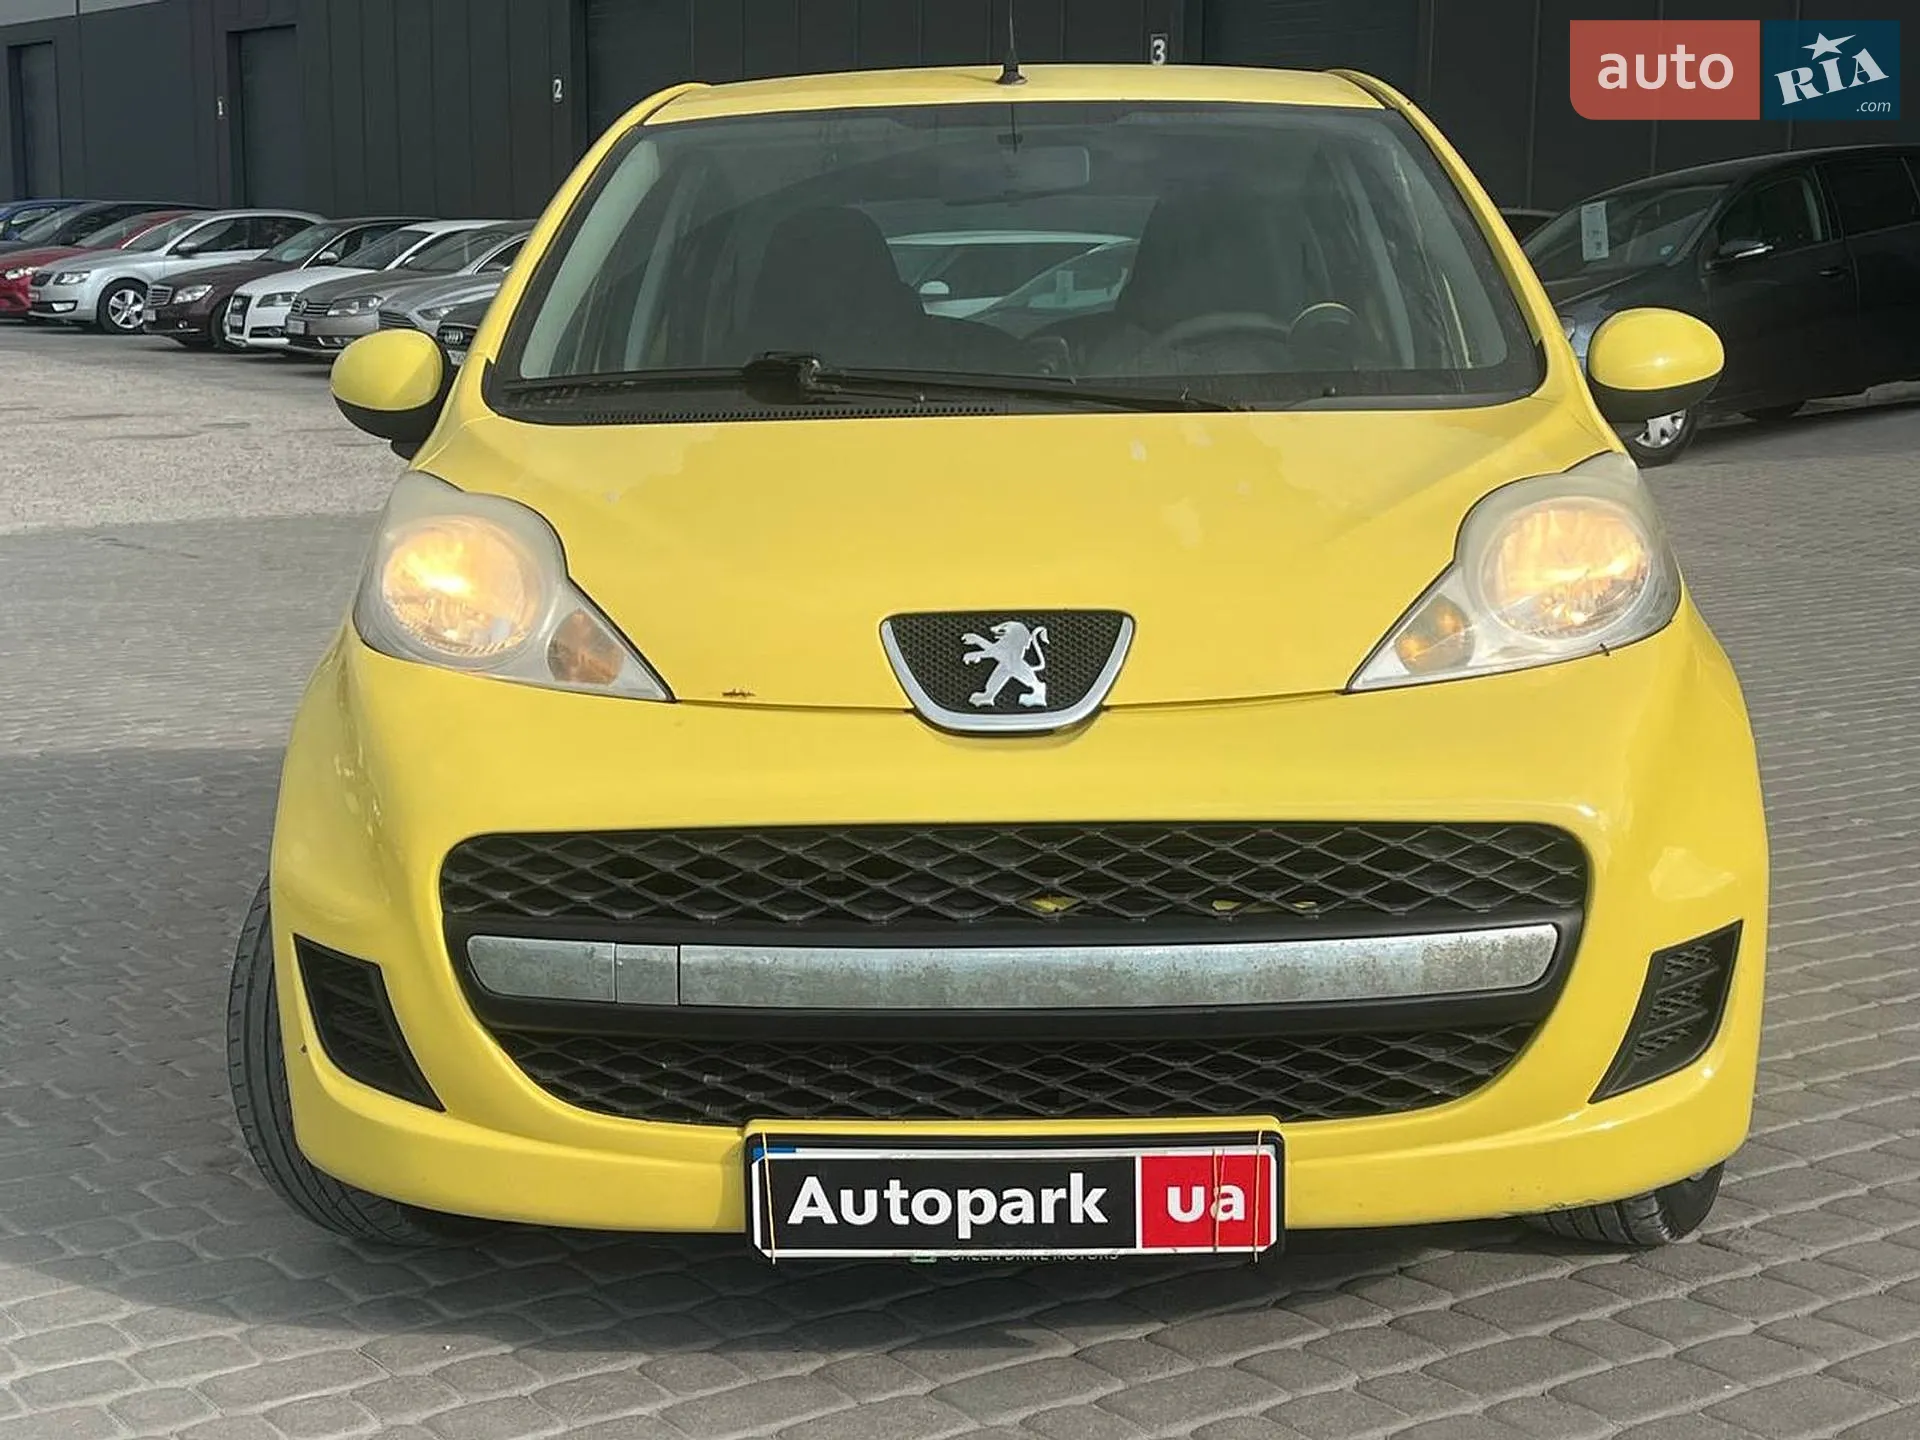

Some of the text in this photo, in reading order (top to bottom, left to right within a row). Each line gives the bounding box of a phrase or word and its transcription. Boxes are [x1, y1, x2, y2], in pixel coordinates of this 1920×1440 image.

[1152, 39, 1165, 65] 3
[553, 79, 562, 98] 2
[787, 1173, 1245, 1239] Autopark ua
